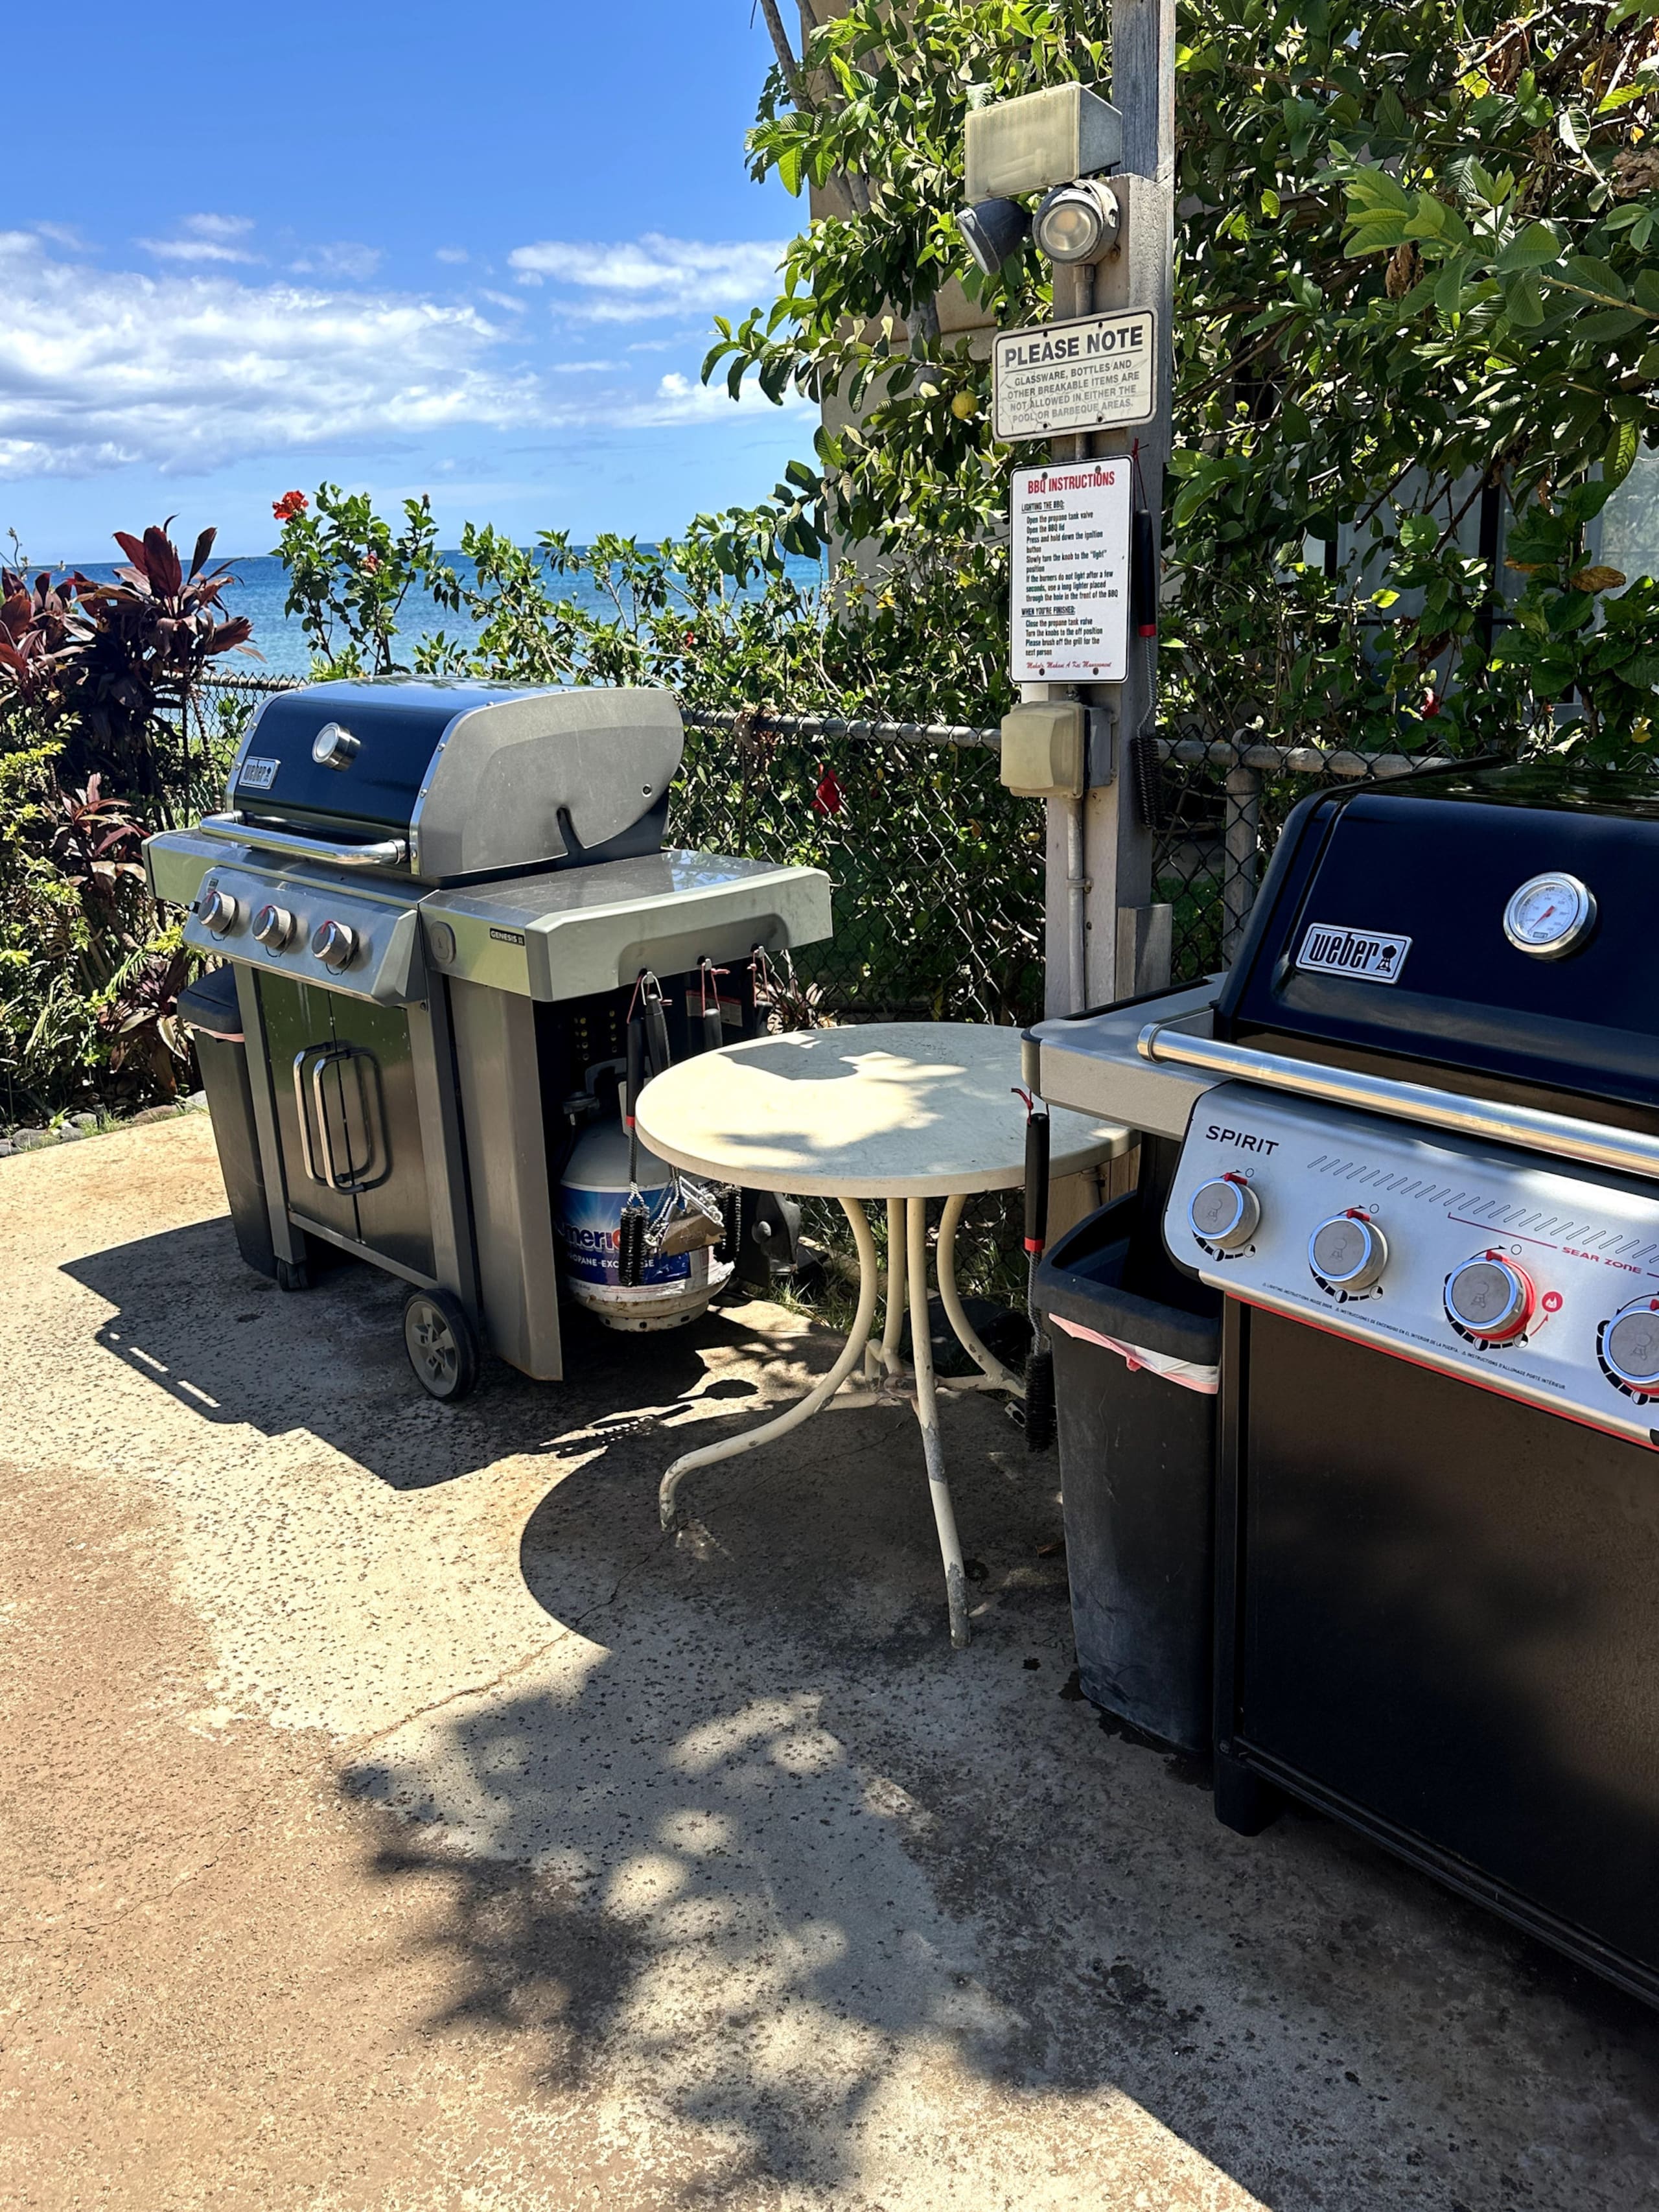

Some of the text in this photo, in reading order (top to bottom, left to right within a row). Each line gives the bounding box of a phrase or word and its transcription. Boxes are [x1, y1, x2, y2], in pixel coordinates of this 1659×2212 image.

[1005, 325, 1143, 367] PLEASE NOTE
[1015, 360, 1131, 386] GLASSWARE, BOTTLES AND
[1008, 371, 1139, 399] OTHER BREAKABLE ITEMS ARE
[1010, 384, 1136, 412] NOT ALLOWED IN EITHER THE
[1013, 398, 1133, 423] POOL OR BARBEQUE AREAS.
[1028, 471, 1115, 495] BBQ INSTRUCTIONS
[1021, 502, 1042, 511] LIGHTING
[1027, 516, 1038, 525] Open
[1048, 515, 1067, 523] propane
[1068, 511, 1079, 520] tank
[1027, 526, 1038, 535] Open
[1048, 524, 1058, 532] BBQ
[1041, 534, 1049, 542] and
[1084, 530, 1103, 541] ignition
[1027, 555, 1041, 564] Slowly
[1062, 552, 1073, 561] knob
[1027, 565, 1045, 574] position
[1074, 571, 1085, 581] light
[1086, 570, 1098, 579] after
[1062, 583, 1071, 591] long
[1073, 582, 1089, 591] lighter
[1090, 580, 1106, 590] placed
[1027, 594, 1043, 603] through
[1108, 589, 1119, 598] BBQ
[1036, 607, 1052, 615] YOU'RE
[1048, 620, 1067, 628] propane
[1084, 627, 1103, 636] position
[1073, 637, 1082, 647] grill
[491, 931, 517, 942] GENESIS
[1309, 932, 1380, 970] weber
[1206, 1125, 1279, 1155] SPIRIT
[1562, 1246, 1600, 1262] SEAR
